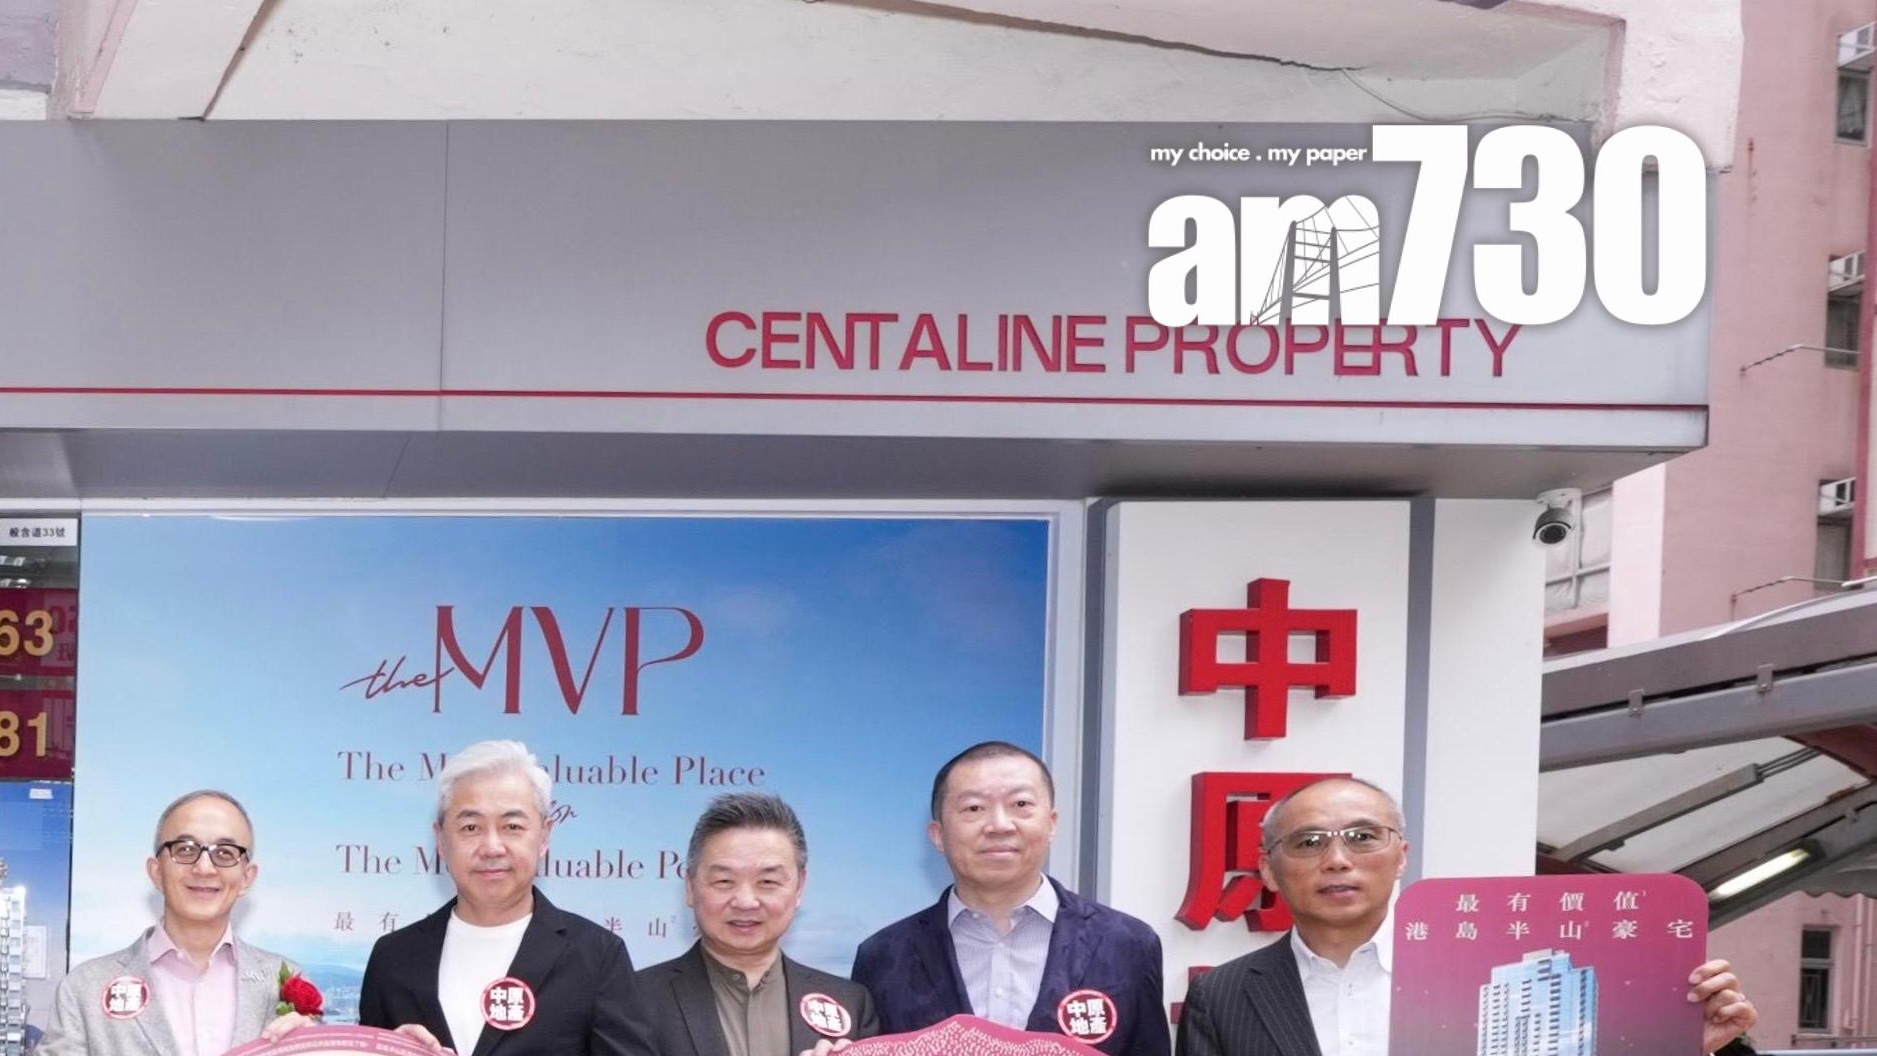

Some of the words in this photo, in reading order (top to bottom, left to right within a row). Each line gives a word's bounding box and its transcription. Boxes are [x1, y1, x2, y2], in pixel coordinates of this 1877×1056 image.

[704, 310, 1107, 374] CENTALINE
[1123, 314, 1525, 378] PROPERTY
[339, 655, 455, 700] the
[431, 605, 705, 716] MVP
[337, 750, 405, 783] The
[540, 755, 660, 787] luable
[672, 754, 767, 787] Place
[334, 843, 402, 876] The
